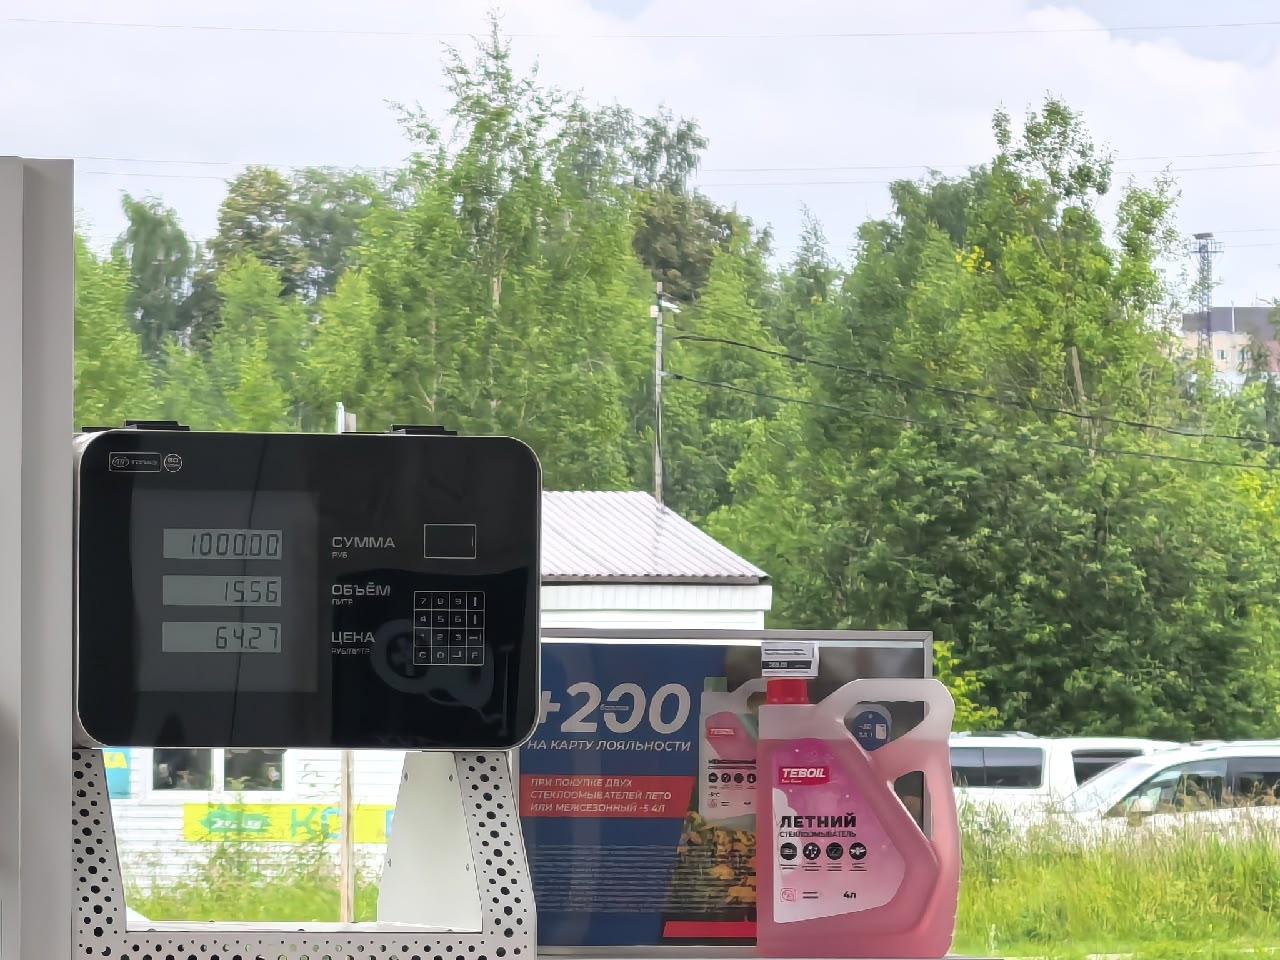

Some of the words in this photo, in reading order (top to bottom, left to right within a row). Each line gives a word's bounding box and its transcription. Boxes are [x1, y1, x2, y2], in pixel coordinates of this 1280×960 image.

[332, 536, 396, 549] СУММА
[331, 631, 376, 645] ЦЕНА
[528, 740, 547, 750] НА
[550, 740, 596, 751] КАРТУ
[596, 740, 691, 752] ЛОЯЛЬНОСТИ
[782, 767, 826, 778] TEBOIL
[531, 778, 552, 787] ПРИ
[555, 778, 603, 787] ПОКУПКЕ
[605, 779, 633, 788] ДВУХ
[644, 791, 672, 800] ЛЕТО
[530, 803, 553, 812] ИЛИ
[555, 802, 637, 813] МЕЖСЕЗОННЫЙ
[780, 812, 857, 828] ЛЕТНИЙ
